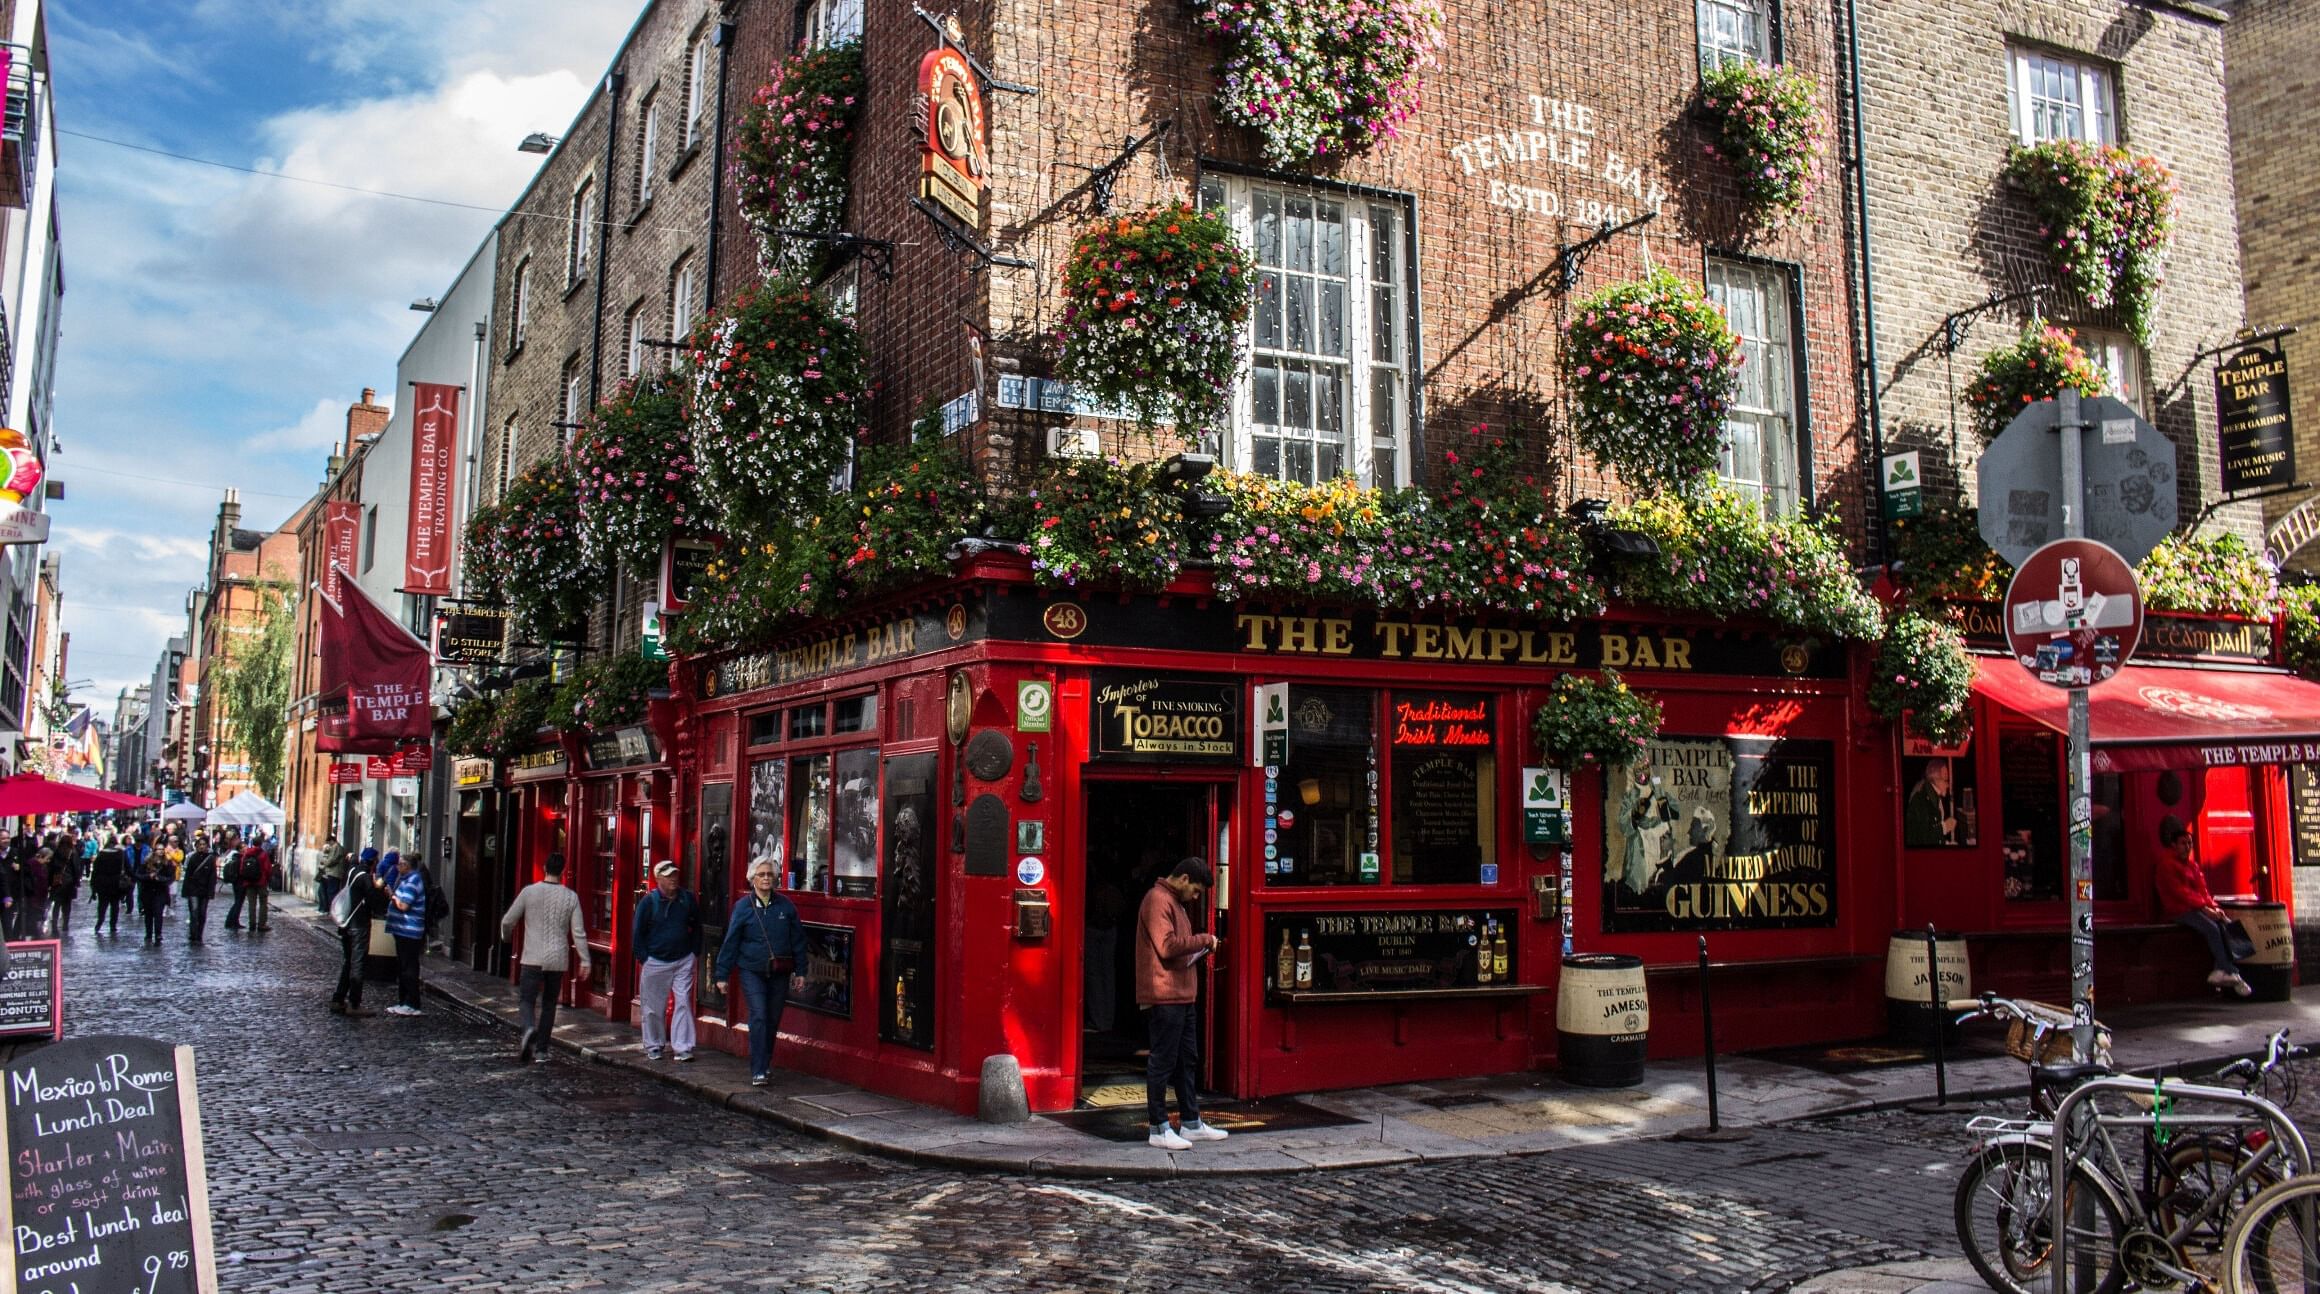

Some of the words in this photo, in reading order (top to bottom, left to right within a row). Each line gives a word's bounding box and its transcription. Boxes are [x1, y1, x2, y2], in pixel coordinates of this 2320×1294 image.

[1528, 94, 1596, 137] THE
[1450, 130, 1590, 177] TEMPLE
[1602, 151, 1668, 216] BAR
[2238, 352, 2261, 366] THE
[2218, 360, 2285, 386] TEMPLE
[2234, 382, 2271, 401] BAR
[2223, 419, 2247, 434] BEER
[2247, 413, 2286, 430] GARDEN
[421, 422, 437, 454] BAR
[2227, 456, 2251, 470] LIVE
[2252, 451, 2286, 465] MUSIC
[2241, 465, 2273, 479] DAILY
[418, 457, 435, 523] TEMPLE
[434, 471, 447, 536] TRADING
[416, 526, 431, 560] THE
[1051, 608, 1078, 630] 48
[777, 633, 857, 685] TEMPLE
[866, 618, 916, 661] BAR
[1238, 614, 1354, 655] THE
[1375, 621, 1577, 665] TEMPLE
[1601, 634, 1692, 670] BAR
[374, 684, 404, 695] THE
[1097, 678, 1159, 704] Importers
[1136, 694, 1147, 702] OF
[353, 692, 423, 709] TEMPLE
[1152, 700, 1175, 711] FINE
[1176, 701, 1222, 713] SMOKING
[1397, 700, 1485, 721] Traditional
[371, 707, 408, 721] BAR
[1024, 715, 1044, 723] Official
[1023, 721, 1046, 729] Member
[1113, 705, 1223, 746] TOBACCO
[1394, 723, 1436, 745] Irish
[1443, 724, 1490, 745] Music
[1136, 739, 1178, 751] Always
[1184, 740, 1194, 750] in
[1199, 741, 1233, 752] Stock
[2201, 747, 2236, 765] THE
[2238, 745, 2300, 763] TEMPLE
[1647, 748, 1728, 767] TEMPLE
[1413, 758, 1452, 779] TEMPLE
[1672, 768, 1711, 789] BAR
[1787, 766, 1818, 788] THE
[1748, 791, 1818, 815] EMPEROR
[1802, 820, 1819, 842] OF
[1704, 854, 1764, 880] MALTED
[1765, 845, 1825, 875] LIQUORS
[1665, 882, 1828, 919] GUINNESS
[1316, 916, 1355, 935] THE
[1360, 915, 1433, 935] TEMPLE
[1378, 935, 1416, 947] DUBLIN
[1360, 966, 1380, 976] LIVE
[1408, 964, 1433, 975] DAILY
[1910, 956, 1925, 964] THE
[2, 969, 48, 980] OFFEE
[1914, 971, 1965, 988] JAESON
[1597, 988, 1615, 998] THE
[0, 1005, 48, 1015] DONUTS
[12, 1067, 95, 1106] Mexico
[96, 1063, 112, 1092] to
[105, 1053, 174, 1092] Rome
[35, 1099, 103, 1136] Lunch
[105, 1092, 155, 1123] Deal
[18, 1142, 95, 1178] Starter
[117, 1130, 175, 1162] Main
[15, 1181, 43, 1200] with
[51, 1177, 93, 1199] glass
[102, 1169, 122, 1189] of
[132, 1165, 168, 1180] wine
[38, 1202, 55, 1214] or
[71, 1190, 108, 1209] soft
[122, 1185, 161, 1201] drink
[14, 1215, 79, 1254] Best
[86, 1205, 140, 1239] lunch
[151, 1195, 189, 1225] deal
[24, 1244, 101, 1281] around
